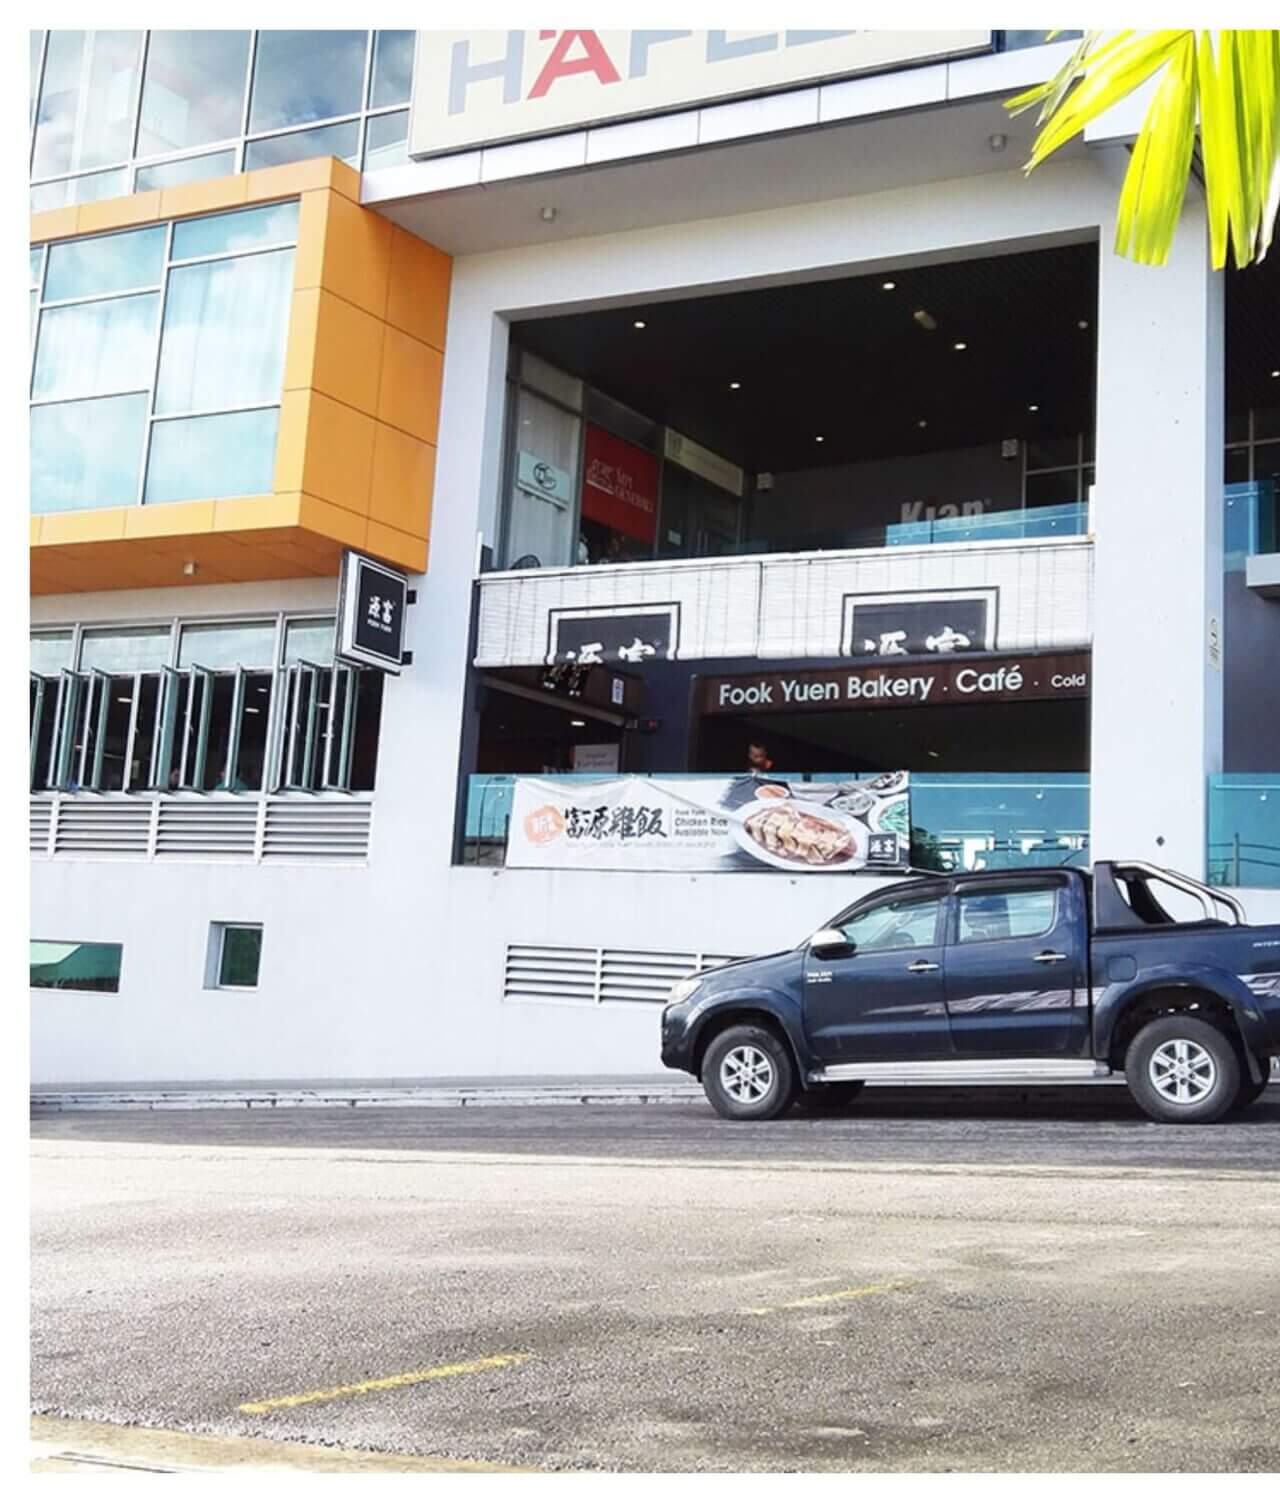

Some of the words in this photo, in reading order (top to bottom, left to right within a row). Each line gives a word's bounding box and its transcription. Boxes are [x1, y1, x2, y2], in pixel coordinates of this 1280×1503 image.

[447, 29, 873, 116] HÄF
[719, 682, 773, 706] Fook
[780, 680, 839, 702] Yuen
[847, 674, 935, 701] Bakery
[956, 664, 1023, 693] Café
[1051, 673, 1086, 688] Cold
[674, 816, 708, 827] Chicken
[710, 816, 728, 827] Rice
